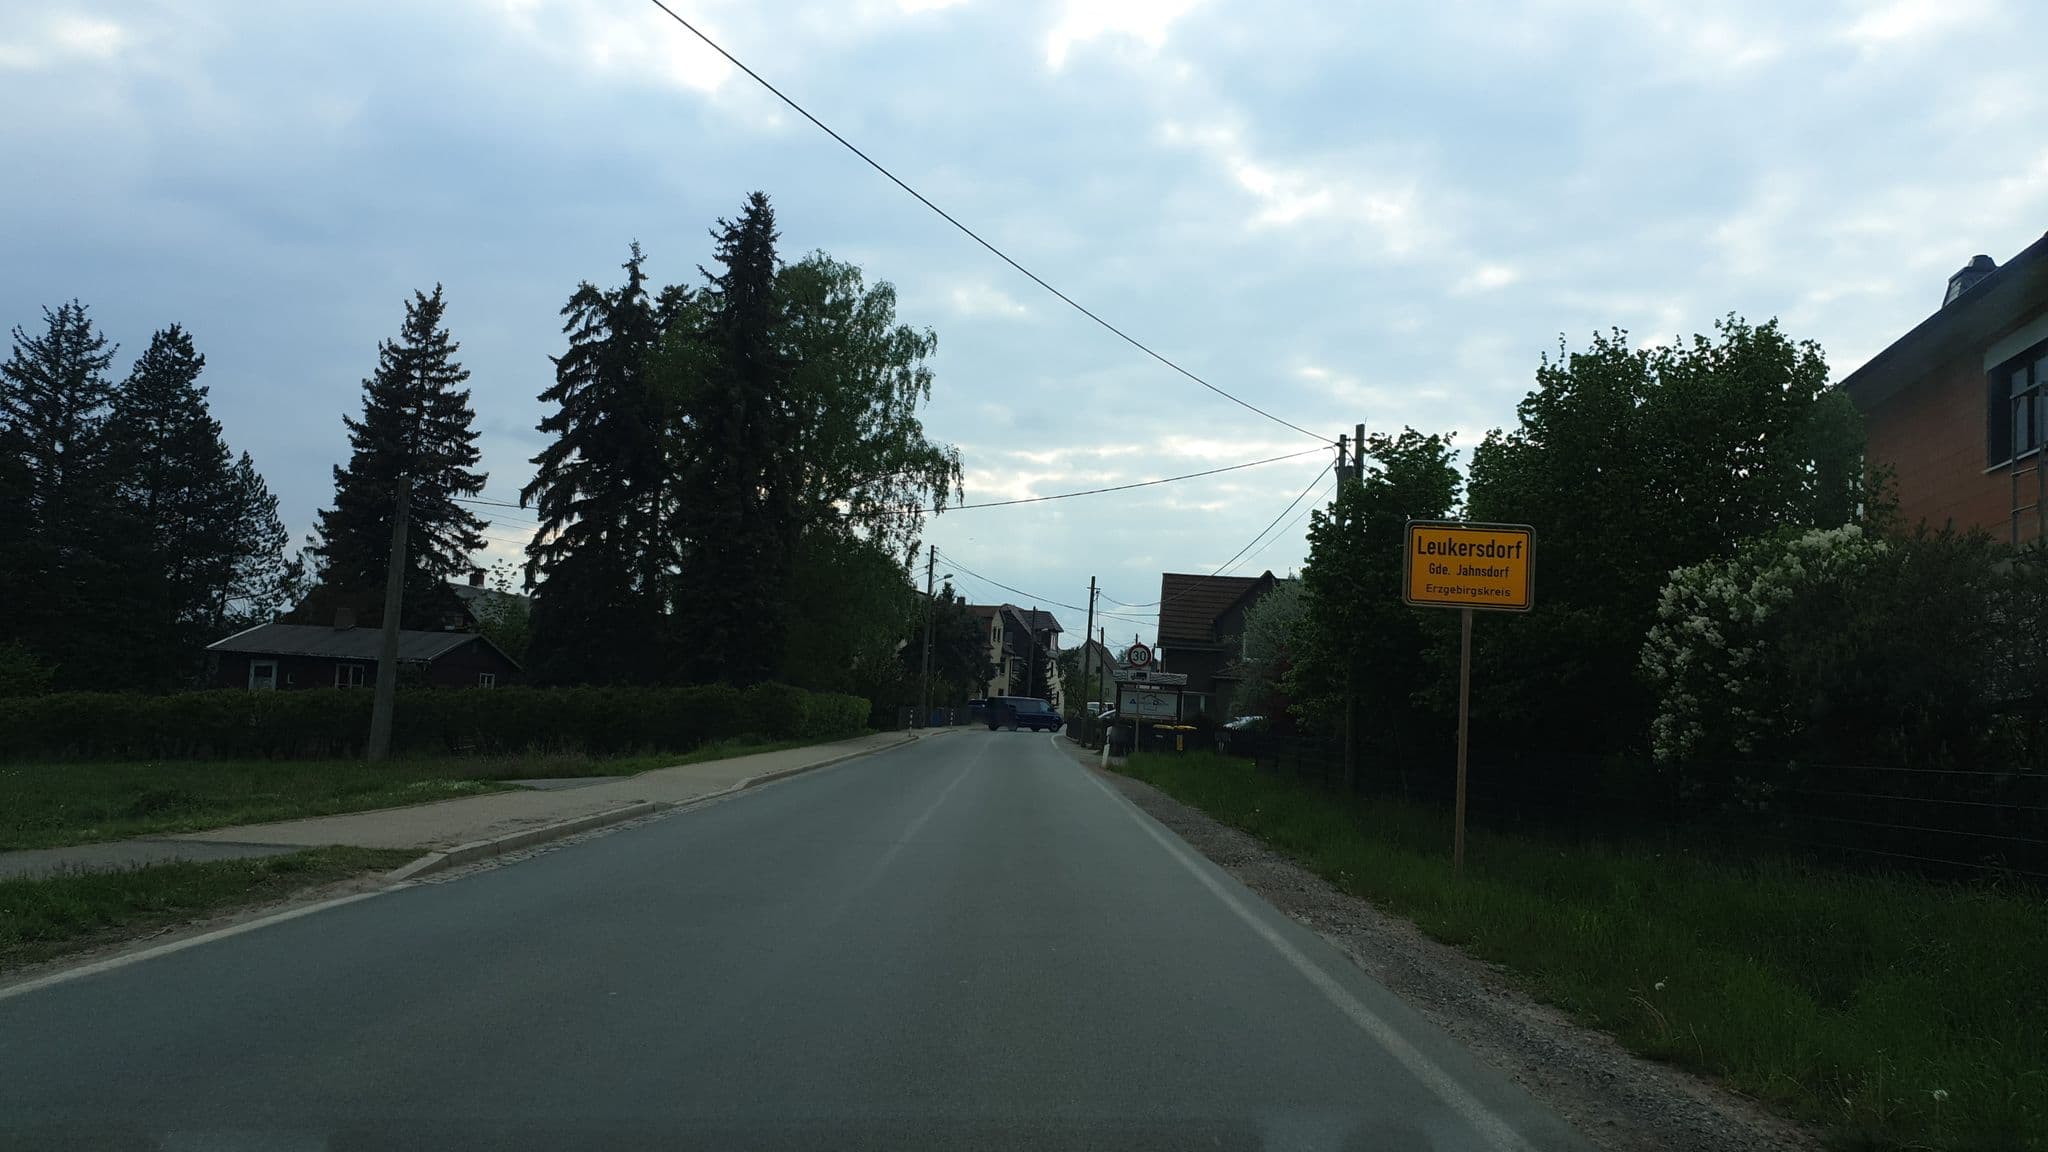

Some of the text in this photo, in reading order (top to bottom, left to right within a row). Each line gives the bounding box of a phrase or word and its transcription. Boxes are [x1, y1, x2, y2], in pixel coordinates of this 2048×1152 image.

[1418, 536, 1522, 559] Leukersdorf
[1429, 562, 1509, 578] Gde. Jahnsdorf
[1426, 584, 1511, 598] Erzgebirgskreis
[1133, 650, 1147, 662] 30
